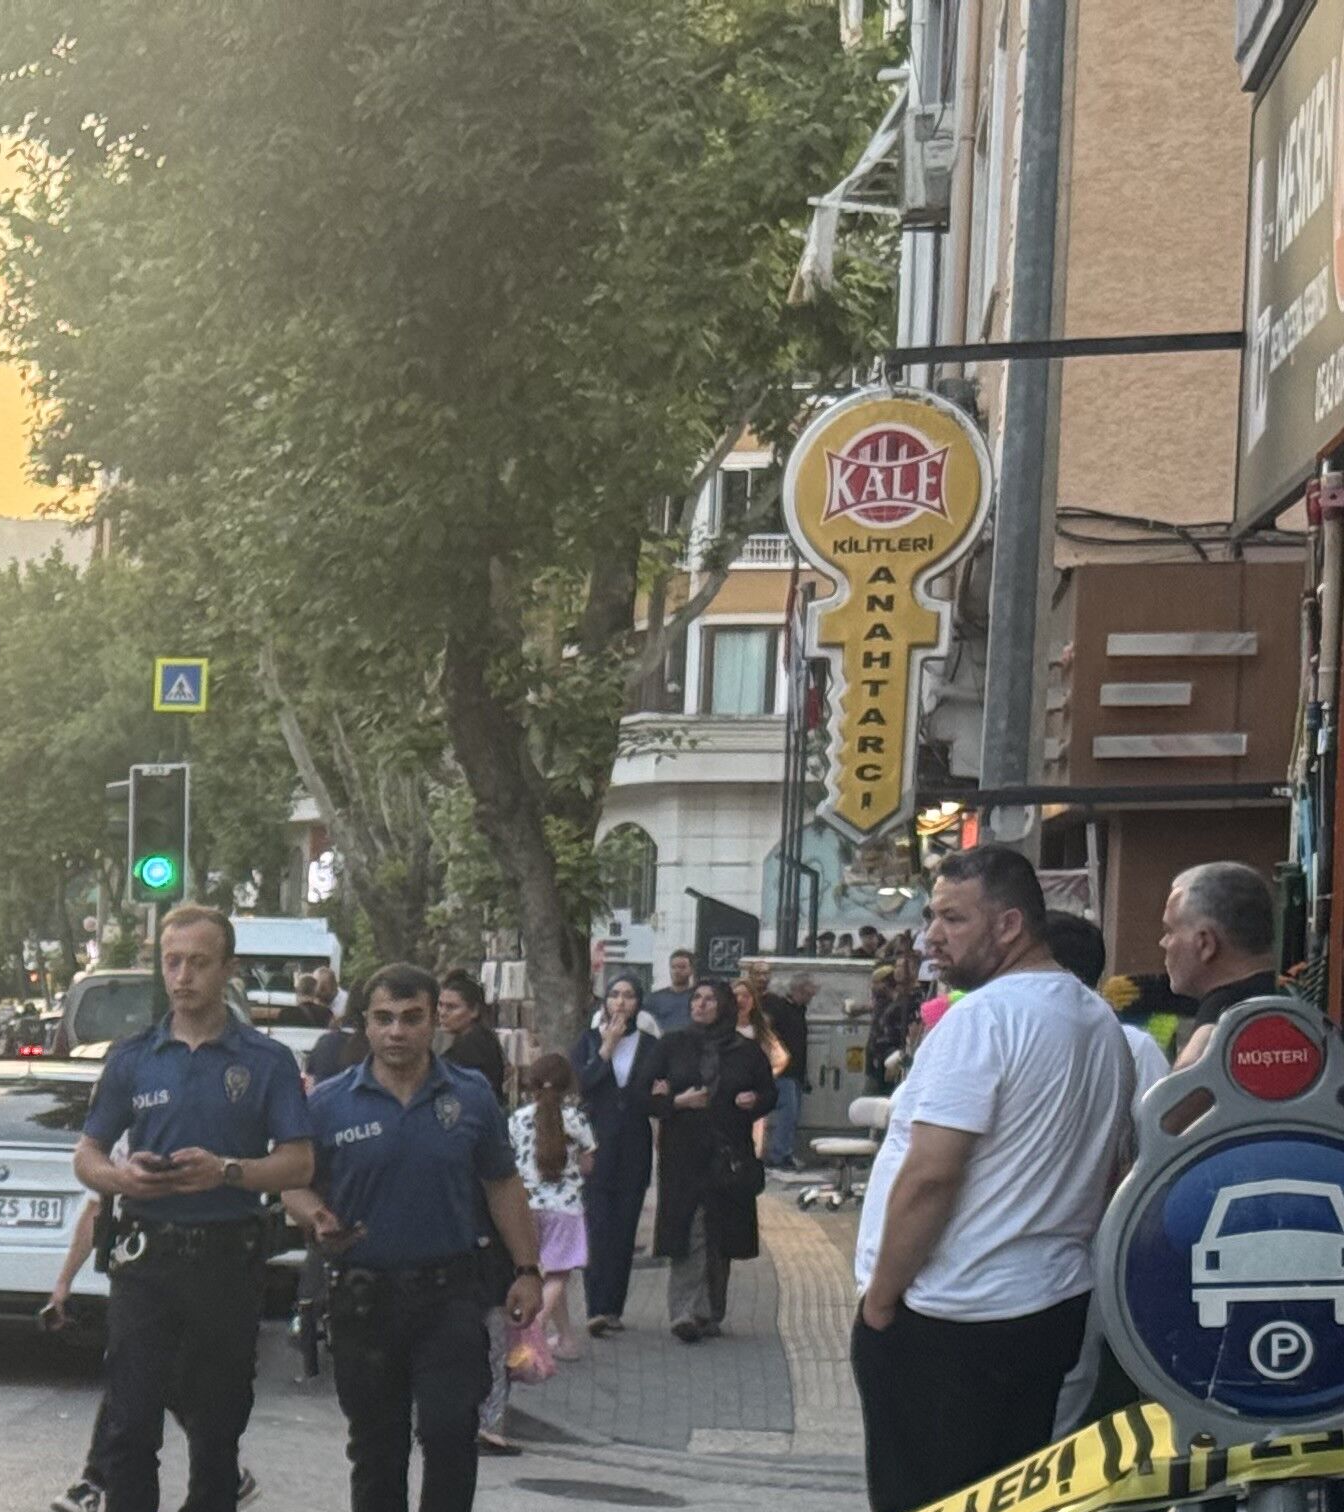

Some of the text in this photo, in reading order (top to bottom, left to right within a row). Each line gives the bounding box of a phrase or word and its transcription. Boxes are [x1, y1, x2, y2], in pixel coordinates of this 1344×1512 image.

[829, 453, 942, 514] KALE
[833, 534, 934, 555] KİLİTLERİ
[855, 566, 897, 810] ANAHTARCI
[1238, 1048, 1308, 1068] MÜŞTERİ
[29, 1200, 59, 1219] 181
[1270, 1331, 1299, 1369] P
